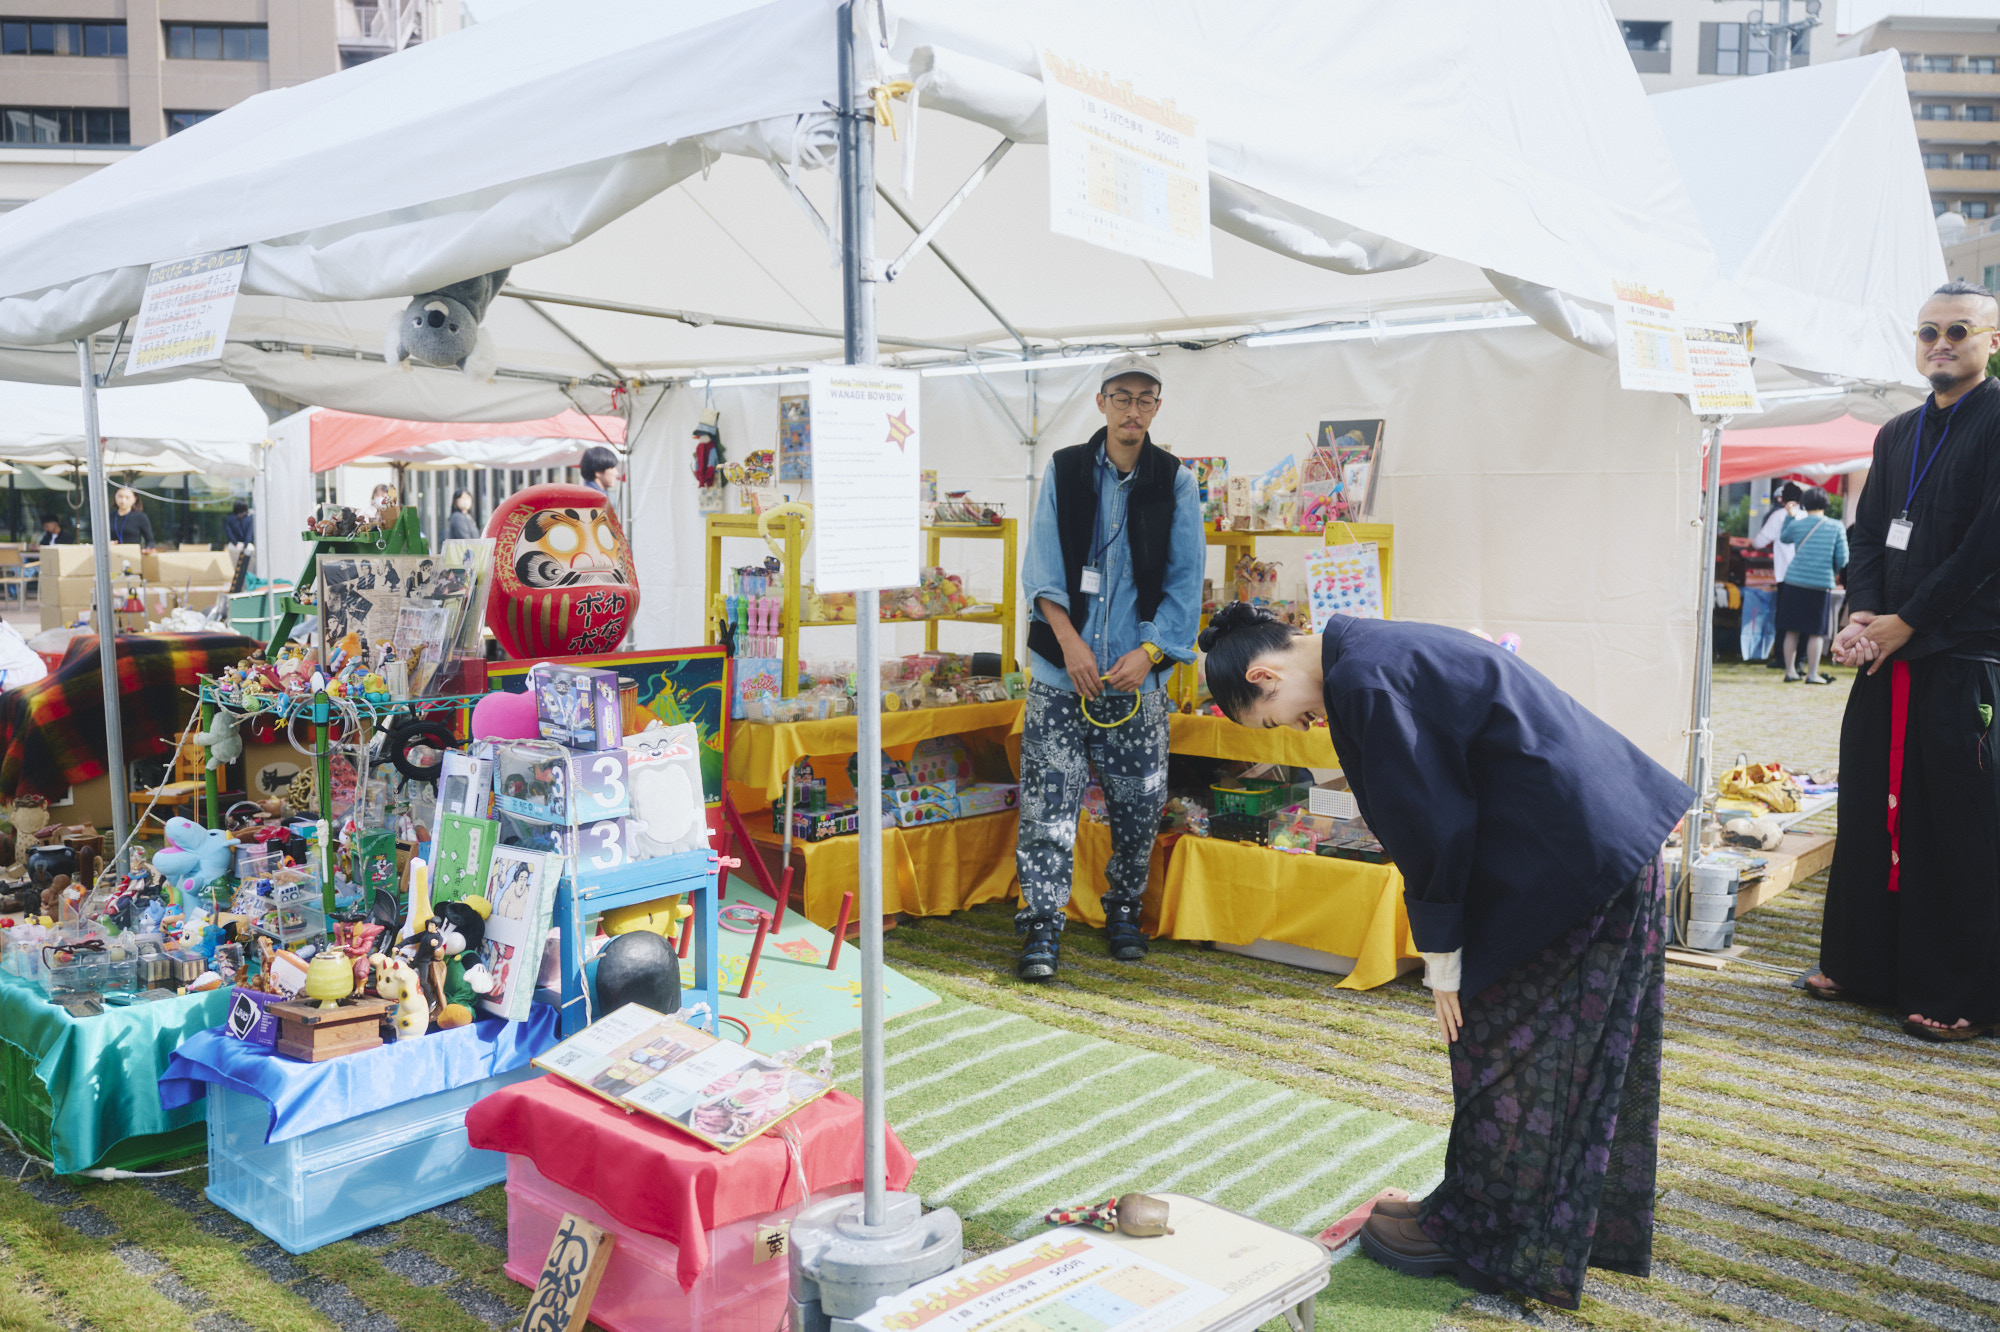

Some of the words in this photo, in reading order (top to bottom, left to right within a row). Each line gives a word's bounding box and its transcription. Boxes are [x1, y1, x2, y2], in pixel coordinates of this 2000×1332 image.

[1155, 130, 1180, 149] 500円
[830, 390, 866, 400] WANAGE
[867, 391, 904, 402] BOWBOW
[567, 590, 606, 656] ボーボ
[592, 756, 626, 808] 3
[590, 820, 623, 870] 3
[881, 1236, 1087, 1331] わなげボーボー
[1050, 1259, 1086, 1277] 500円
[1222, 1260, 1286, 1295] ollection
